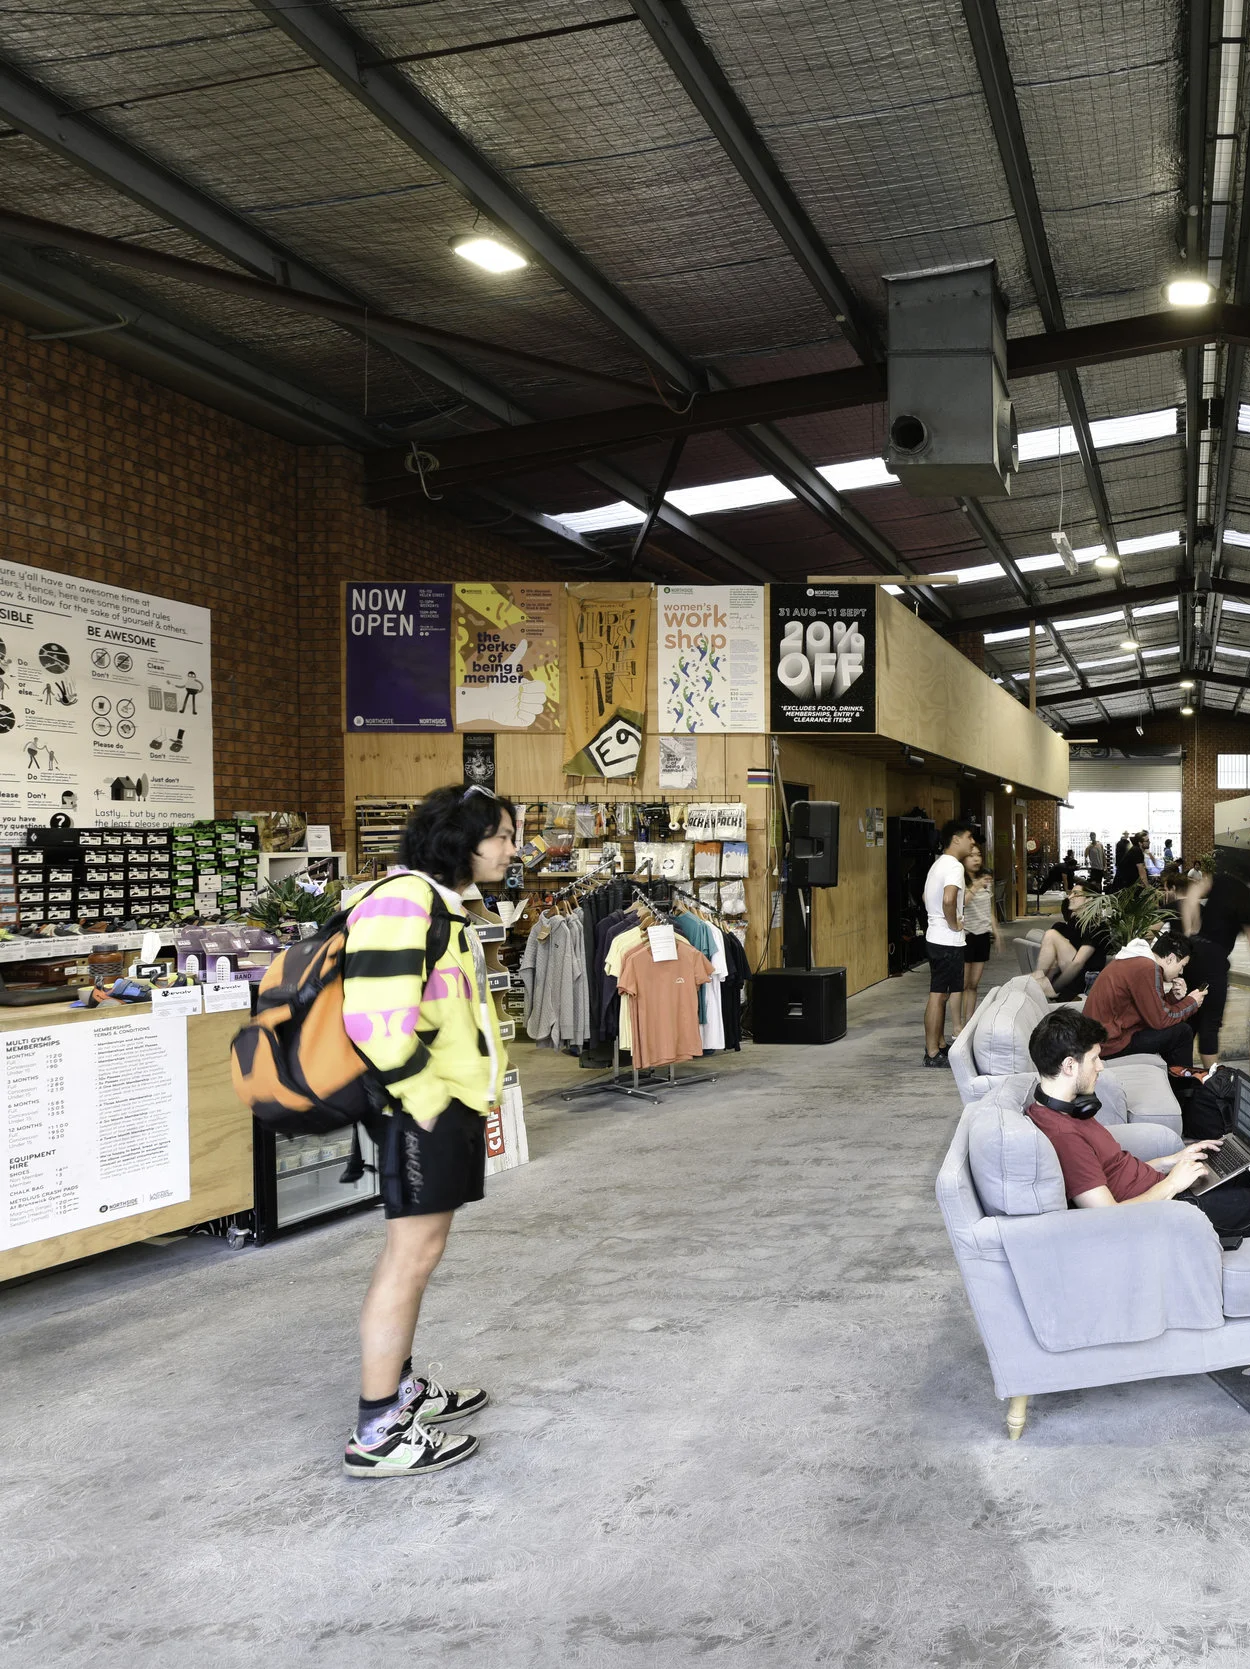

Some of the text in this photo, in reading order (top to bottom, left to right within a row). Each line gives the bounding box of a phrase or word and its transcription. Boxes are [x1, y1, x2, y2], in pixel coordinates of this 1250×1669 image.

[19, 571, 38, 581] y'all
[41, 575, 63, 587] have
[79, 585, 119, 600] awesome
[121, 594, 140, 605] time
[24, 582, 56, 598] Hence,
[58, 590, 78, 601] here
[81, 597, 95, 605] are
[97, 601, 120, 610] some
[122, 606, 150, 617] ground
[153, 612, 171, 621] rules
[352, 588, 406, 611] NOW
[664, 602, 711, 611] women's
[17, 591, 25, 601] &
[28, 594, 55, 606] follow
[59, 601, 72, 610] for
[74, 604, 88, 614] the
[90, 608, 110, 619] sake
[112, 613, 120, 621] of
[122, 616, 154, 628] yourself
[163, 624, 188, 634] others.
[664, 604, 727, 628] work
[779, 608, 791, 617] 31
[840, 608, 867, 617] SEPT
[351, 613, 414, 636] OPEN
[87, 626, 157, 647] BE AWESOME
[477, 631, 500, 642] the
[664, 629, 727, 653] shop
[780, 620, 865, 653] 20%
[477, 641, 517, 654] perks
[18, 658, 28, 666] Do
[488, 652, 504, 663] of
[147, 662, 165, 671] Clean
[472, 661, 524, 674] being a
[92, 670, 110, 678] Don't
[777, 652, 864, 692] OFF
[464, 673, 525, 683] member
[93, 740, 114, 749] Please
[130, 809, 144, 817] but
[146, 810, 156, 819] by
[95, 820, 109, 828] the
[234, 973, 252, 981] BAND
[94, 1024, 132, 1033] MEMBERSHIPS
[119, 1026, 150, 1035] CONDITIONS
[5, 1035, 52, 1047] MULTI GYMS
[6, 1039, 60, 1052] MEMBERSHIPS
[6, 1051, 35, 1060] MONTHLY
[13, 1075, 39, 1083] MONTHS
[14, 1099, 40, 1107] MONTHS
[17, 1122, 43, 1131] MONTHS
[9, 1149, 56, 1165] EQUIPMENT
[9, 1161, 29, 1170] HIRE
[9, 1169, 30, 1178] SHOES
[9, 1188, 30, 1197] CHALK
[9, 1184, 79, 1205] METOLIUS CRASH PADS
[109, 1198, 138, 1208] NORTHSIDE
